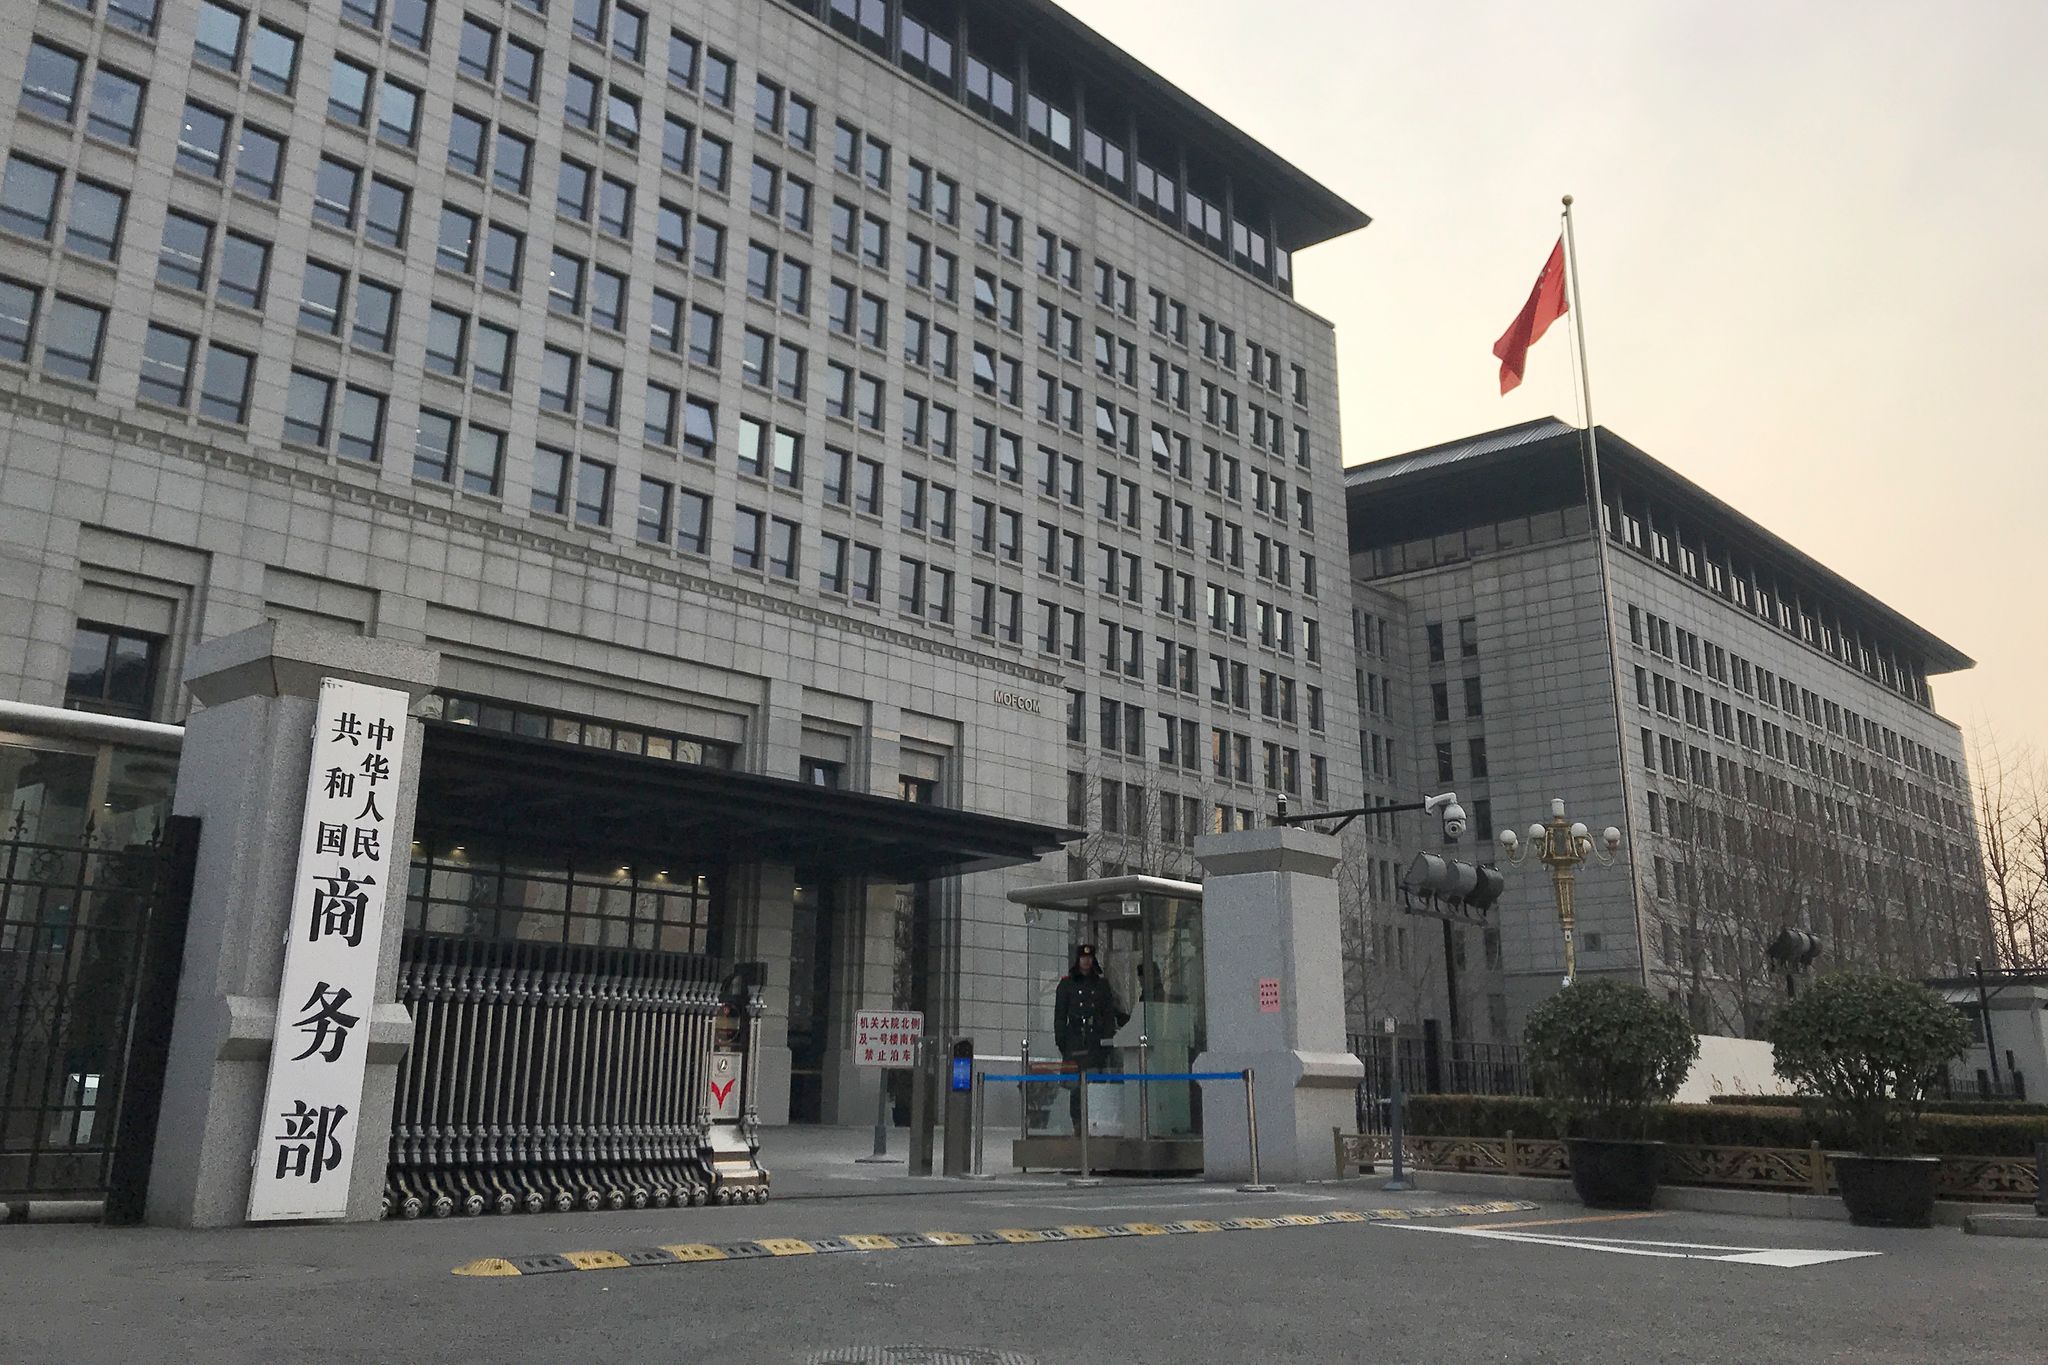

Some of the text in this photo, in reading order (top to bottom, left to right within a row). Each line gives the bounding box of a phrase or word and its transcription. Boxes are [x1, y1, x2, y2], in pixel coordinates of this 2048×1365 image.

[994, 690, 1040, 713] MOFCOM
[315, 711, 363, 857] 共和国
[352, 717, 395, 862] 中华人民
[274, 866, 377, 1184] 商务部
[860, 1016, 921, 1030] 机关大院北侧
[865, 1048, 911, 1062] 禁止泊车
